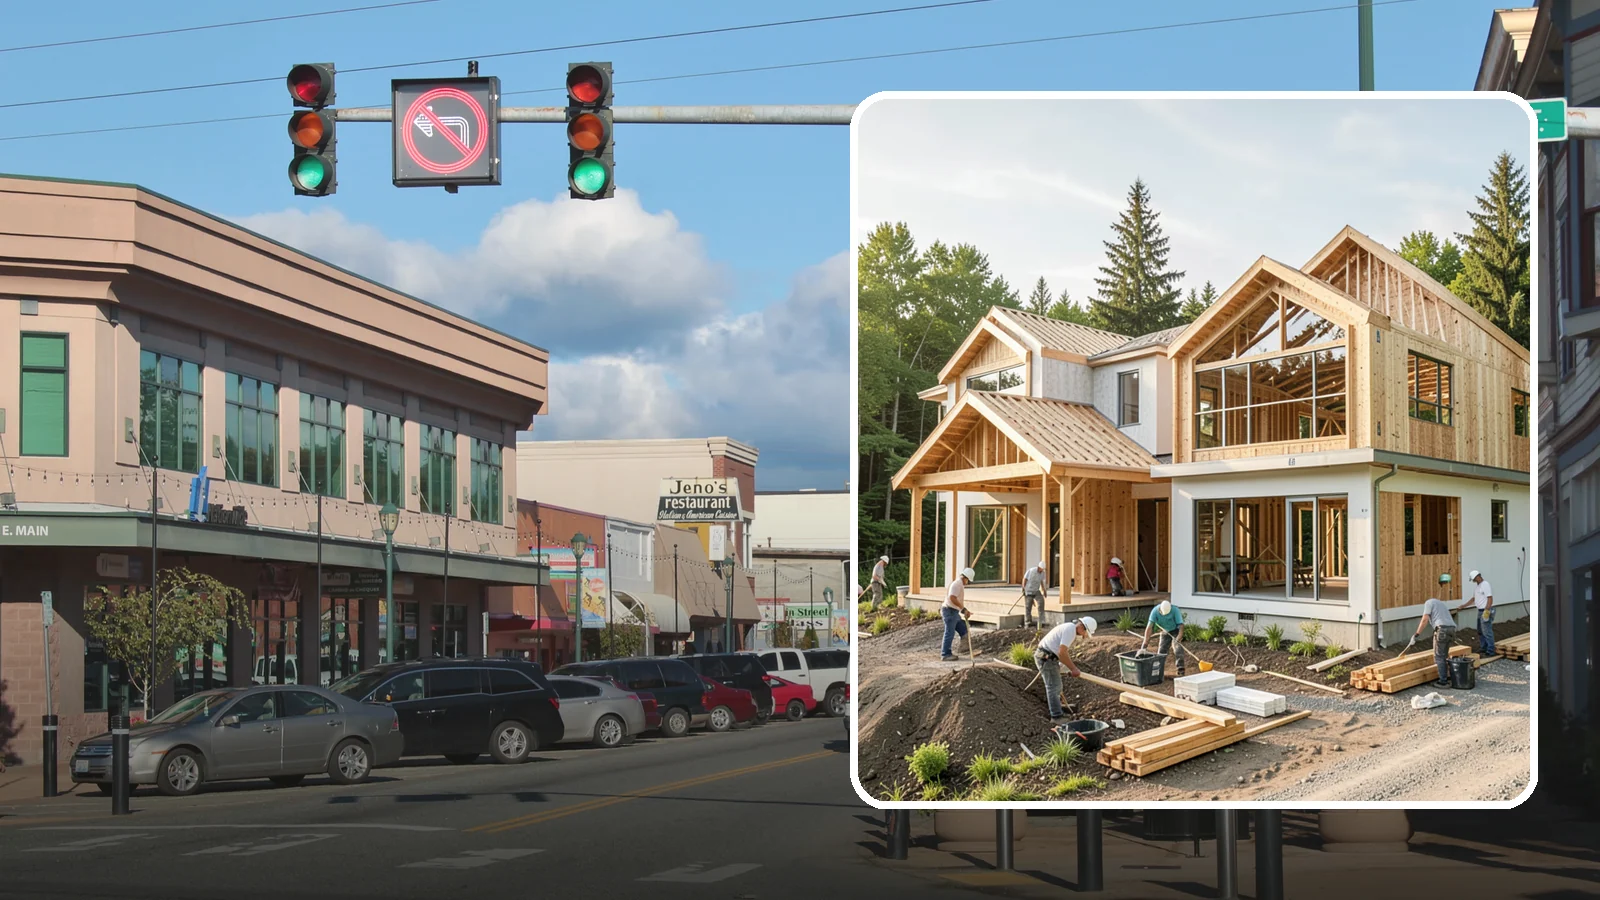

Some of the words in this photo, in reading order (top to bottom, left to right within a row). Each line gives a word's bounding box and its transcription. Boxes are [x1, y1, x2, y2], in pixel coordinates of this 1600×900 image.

[669, 480, 727, 495] Jeno's
[665, 497, 731, 509] restaurant
[658, 510, 682, 520] Italian
[686, 510, 715, 520] American
[715, 510, 738, 519] Cuisine
[2, 525, 13, 536] E.
[15, 525, 49, 536] MAIN
[797, 607, 829, 617] Street
